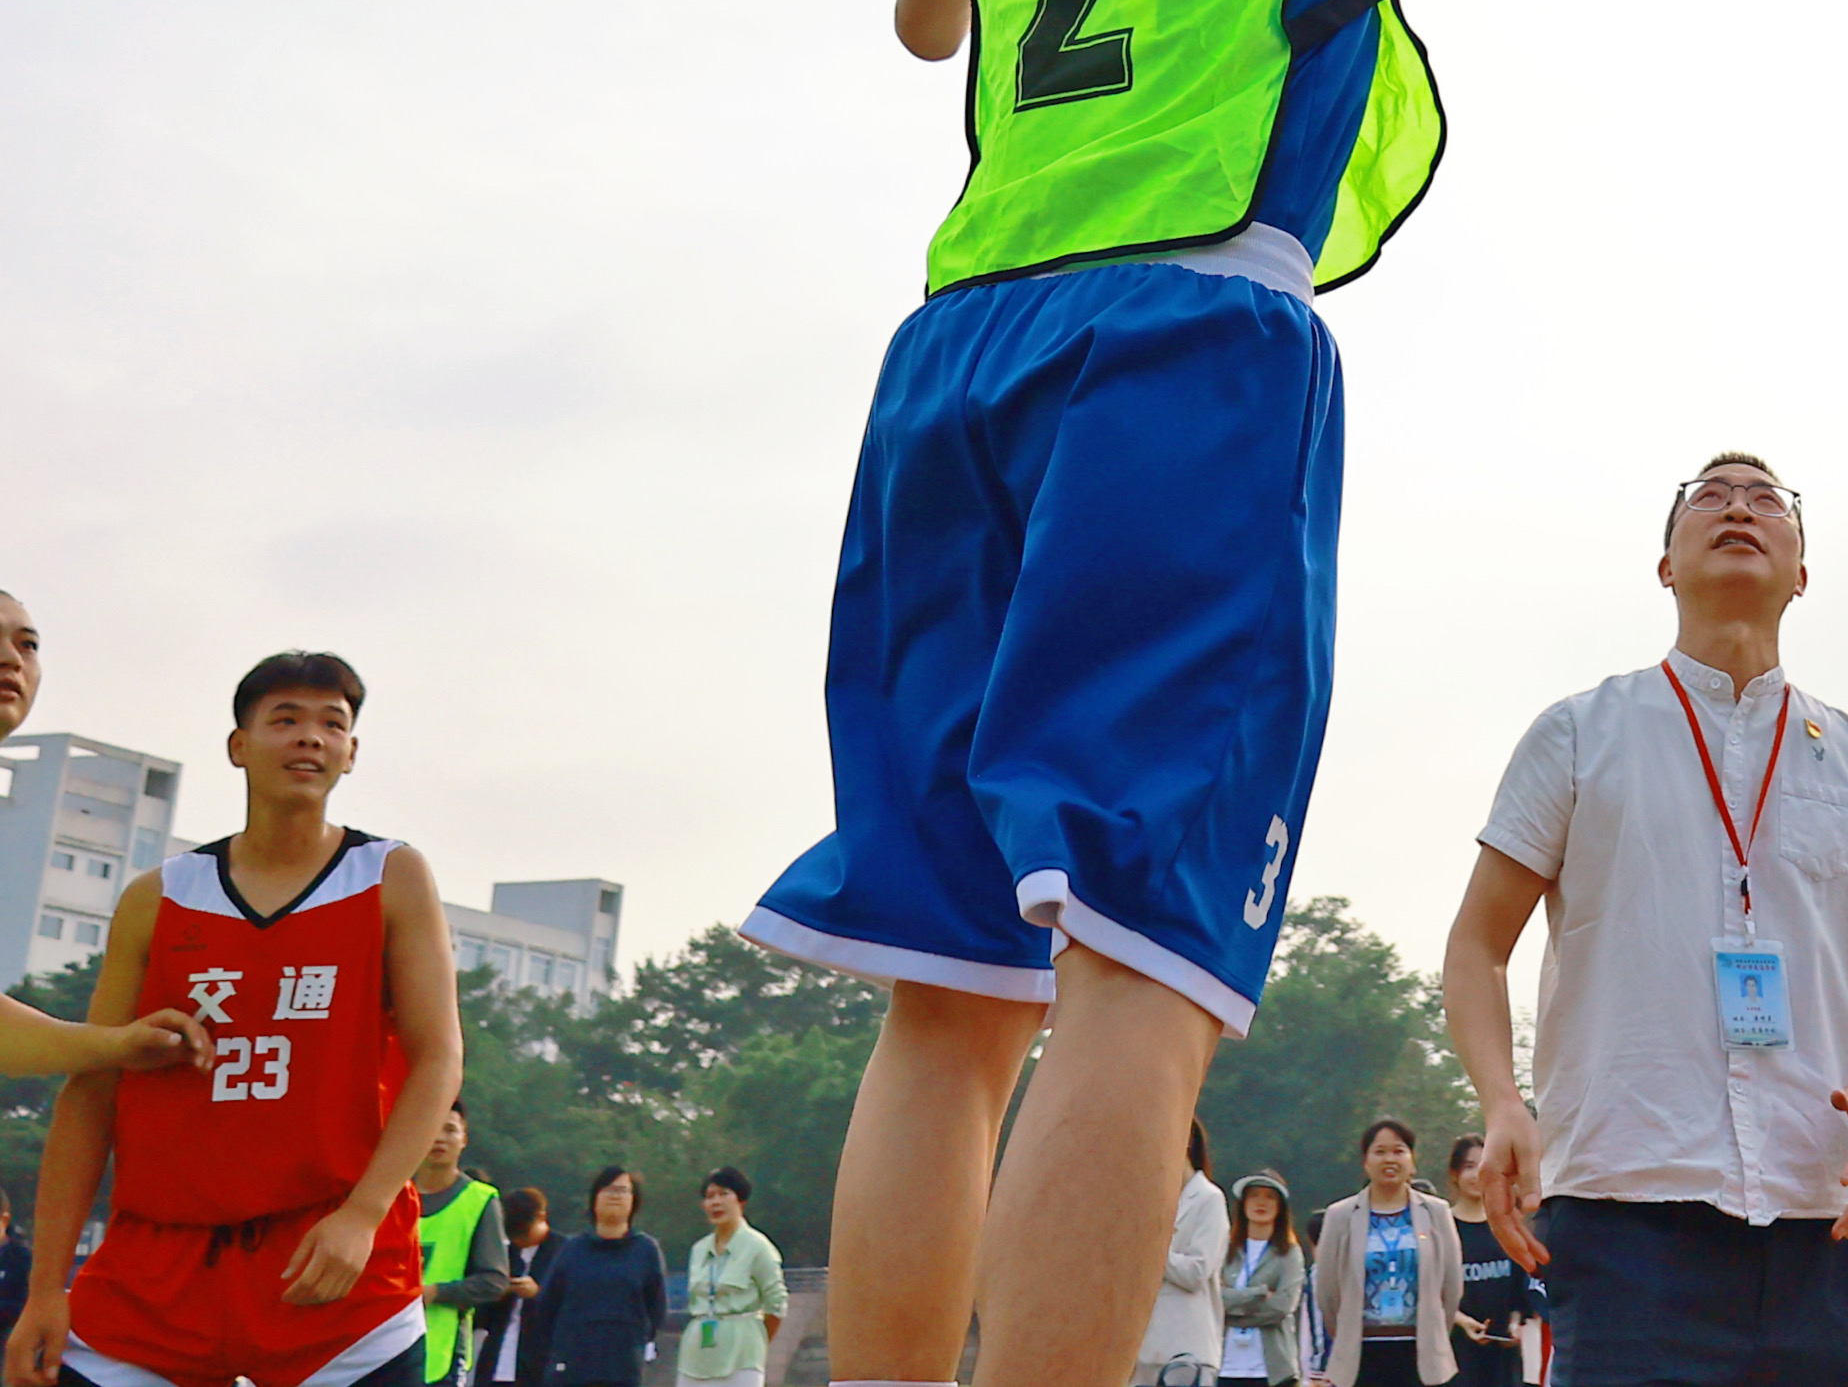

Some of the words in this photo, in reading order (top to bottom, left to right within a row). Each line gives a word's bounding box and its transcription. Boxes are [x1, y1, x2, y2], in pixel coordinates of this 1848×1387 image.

[1242, 812, 1290, 932] 3
[187, 964, 338, 1025] 交通
[211, 1034, 292, 1103] 23
